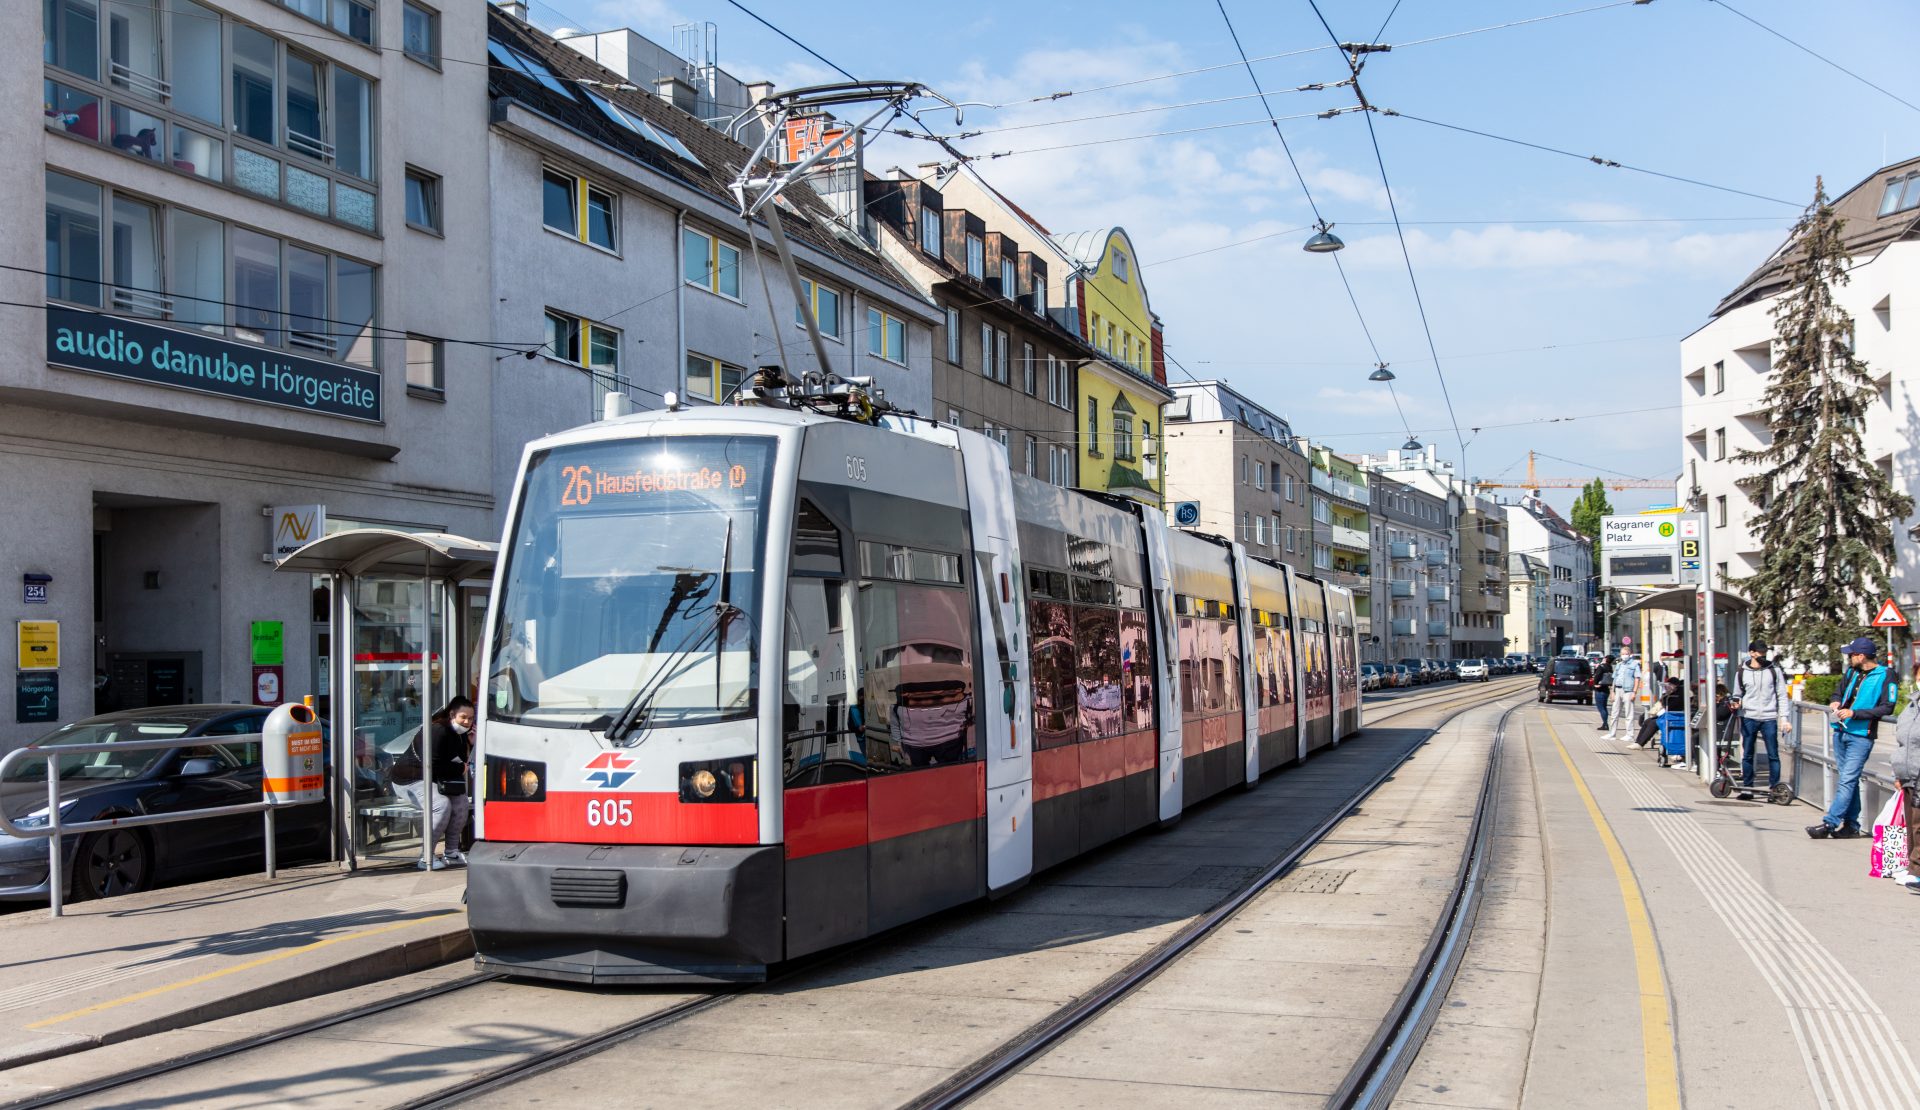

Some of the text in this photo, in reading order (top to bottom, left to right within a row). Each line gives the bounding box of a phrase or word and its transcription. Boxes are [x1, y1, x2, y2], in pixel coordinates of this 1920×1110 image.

[56, 327, 375, 409] audio danube Hörgeräte
[846, 455, 867, 481] 605
[561, 465, 592, 505] 26
[596, 467, 722, 495] Hausfeldstraße
[1606, 521, 1655, 531] Kagraner
[1606, 533, 1633, 542] Platz
[1683, 541, 1698, 557] B
[27, 586, 45, 597] 254
[587, 798, 633, 827] 605
